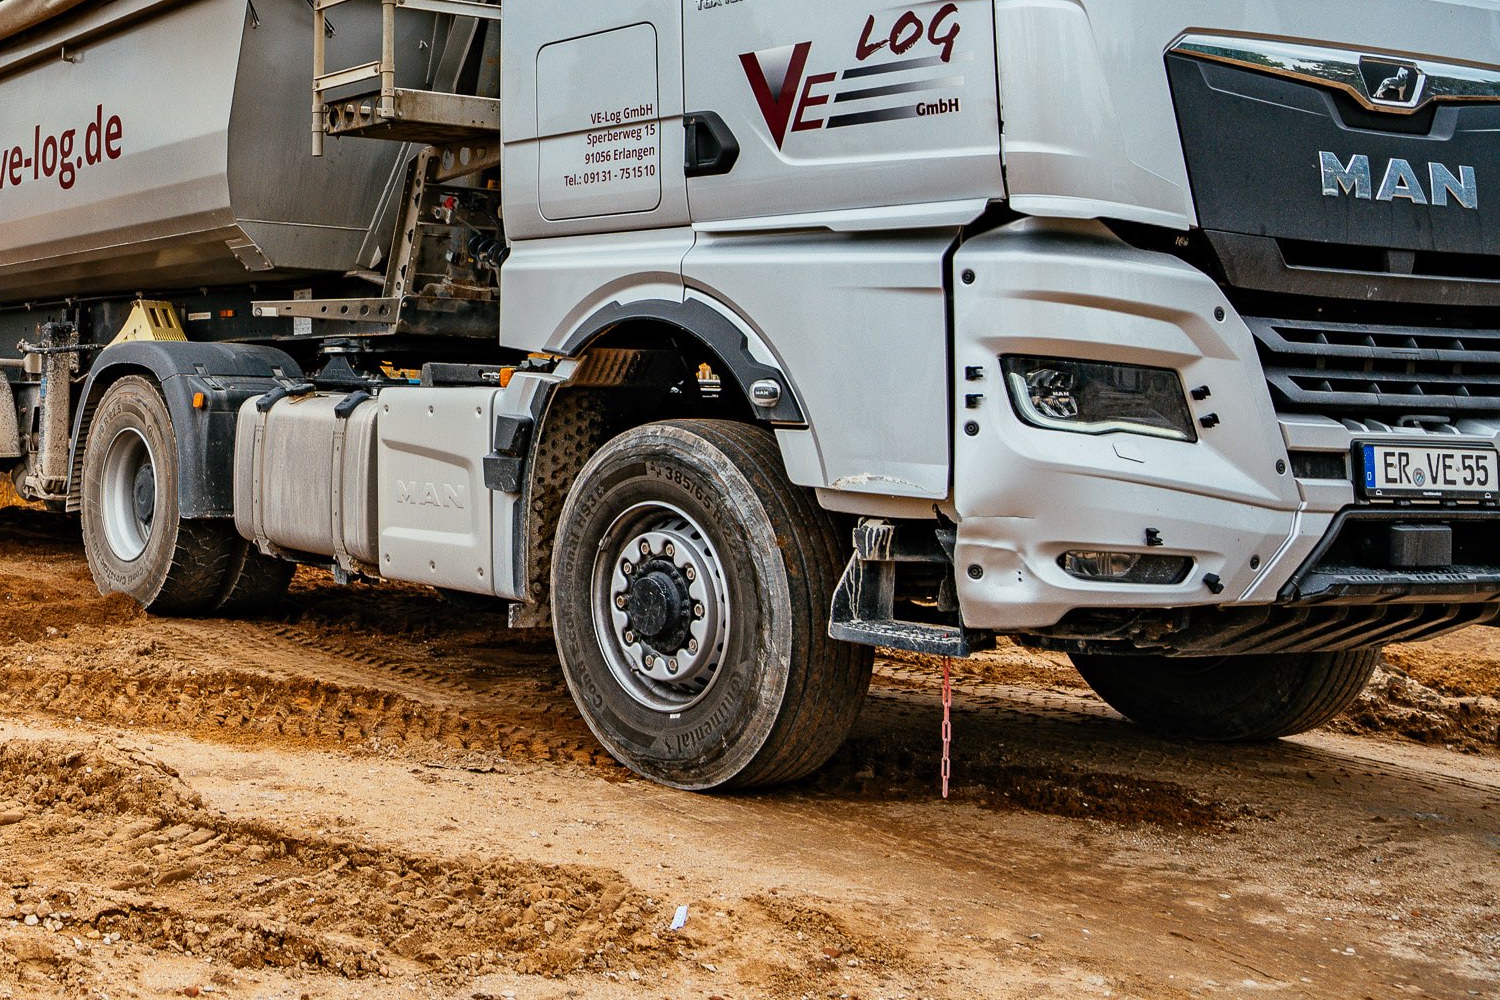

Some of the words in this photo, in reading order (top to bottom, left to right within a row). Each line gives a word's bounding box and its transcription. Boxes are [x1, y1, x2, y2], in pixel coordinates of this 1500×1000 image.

[855, 3, 961, 63] LOG
[738, 41, 837, 152] VE
[915, 98, 960, 118] GmbH
[591, 111, 621, 124] VE-Log
[624, 104, 653, 119] GmbH
[587, 128, 642, 147] Sperberweg
[645, 124, 655, 136] 15
[585, 151, 611, 164] 91056
[614, 146, 655, 160] Erlangen
[564, 174, 581, 187] Tel.:
[1319, 150, 1478, 209] MAN
[1384, 452, 1411, 484] ER
[1426, 453, 1457, 485] VE
[1461, 454, 1489, 486] 55
[395, 479, 465, 510] MAN
[665, 466, 711, 509] 385/65
